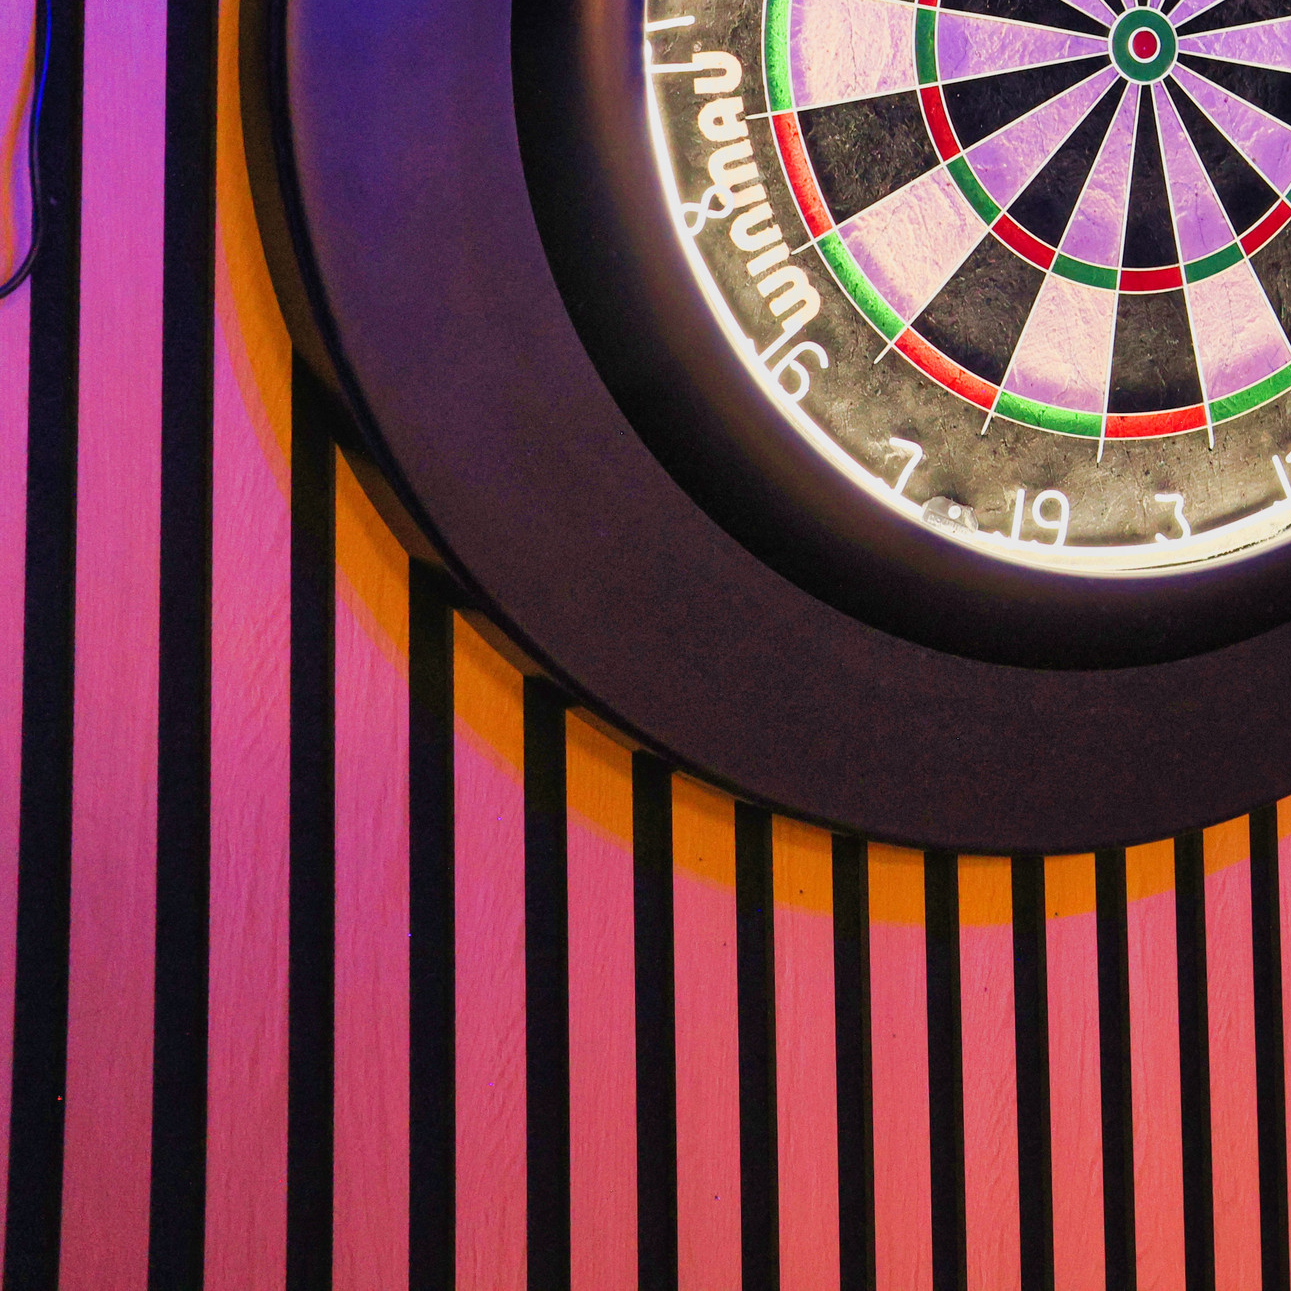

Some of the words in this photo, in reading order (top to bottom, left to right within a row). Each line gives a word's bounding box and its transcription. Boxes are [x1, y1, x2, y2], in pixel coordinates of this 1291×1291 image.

[888, 436, 924, 496] 7
[1009, 488, 1071, 547] 19
[1153, 492, 1193, 544] 3
